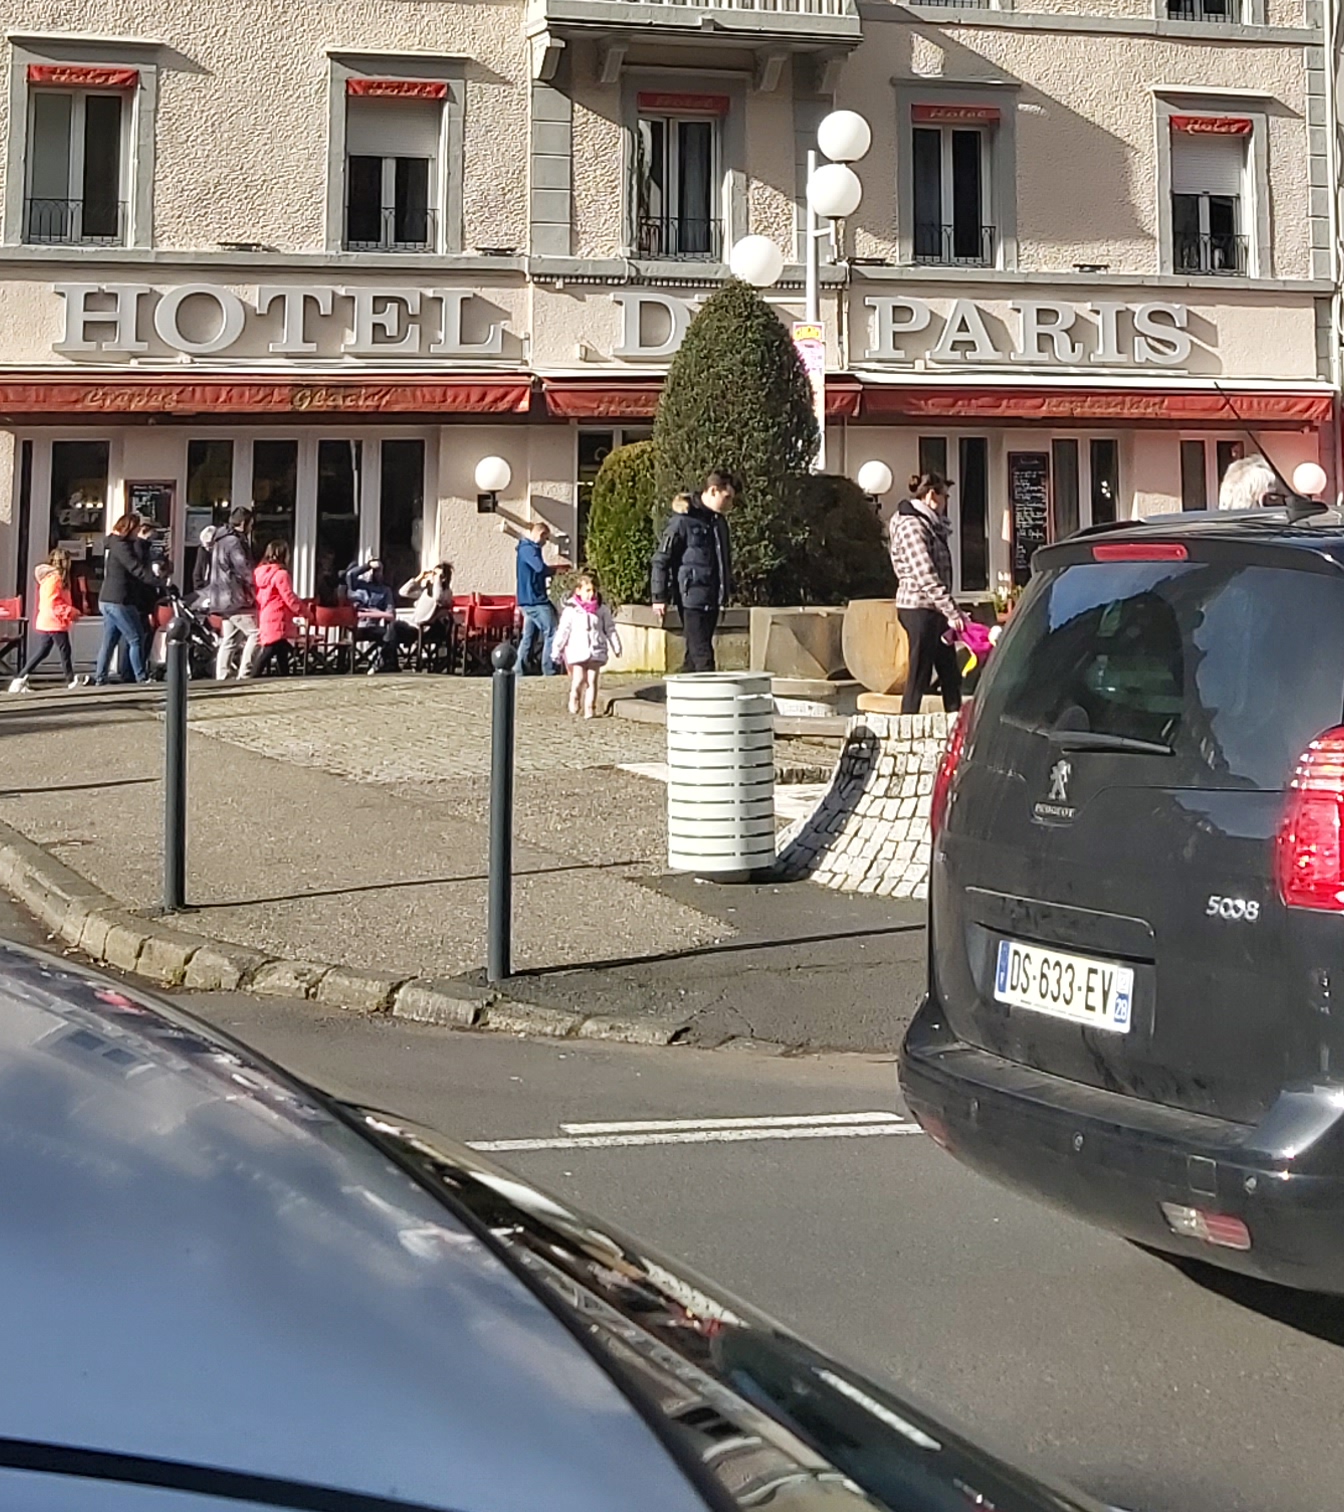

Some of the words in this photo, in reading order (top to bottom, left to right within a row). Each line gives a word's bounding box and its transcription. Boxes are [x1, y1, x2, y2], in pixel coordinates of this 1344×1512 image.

[51, 282, 505, 354] HOTEL
[864, 295, 1193, 366] PARIS
[1206, 895, 1260, 920] 5008
[1010, 948, 1114, 1015] DS-633-EV
[1115, 998, 1128, 1021] 28
